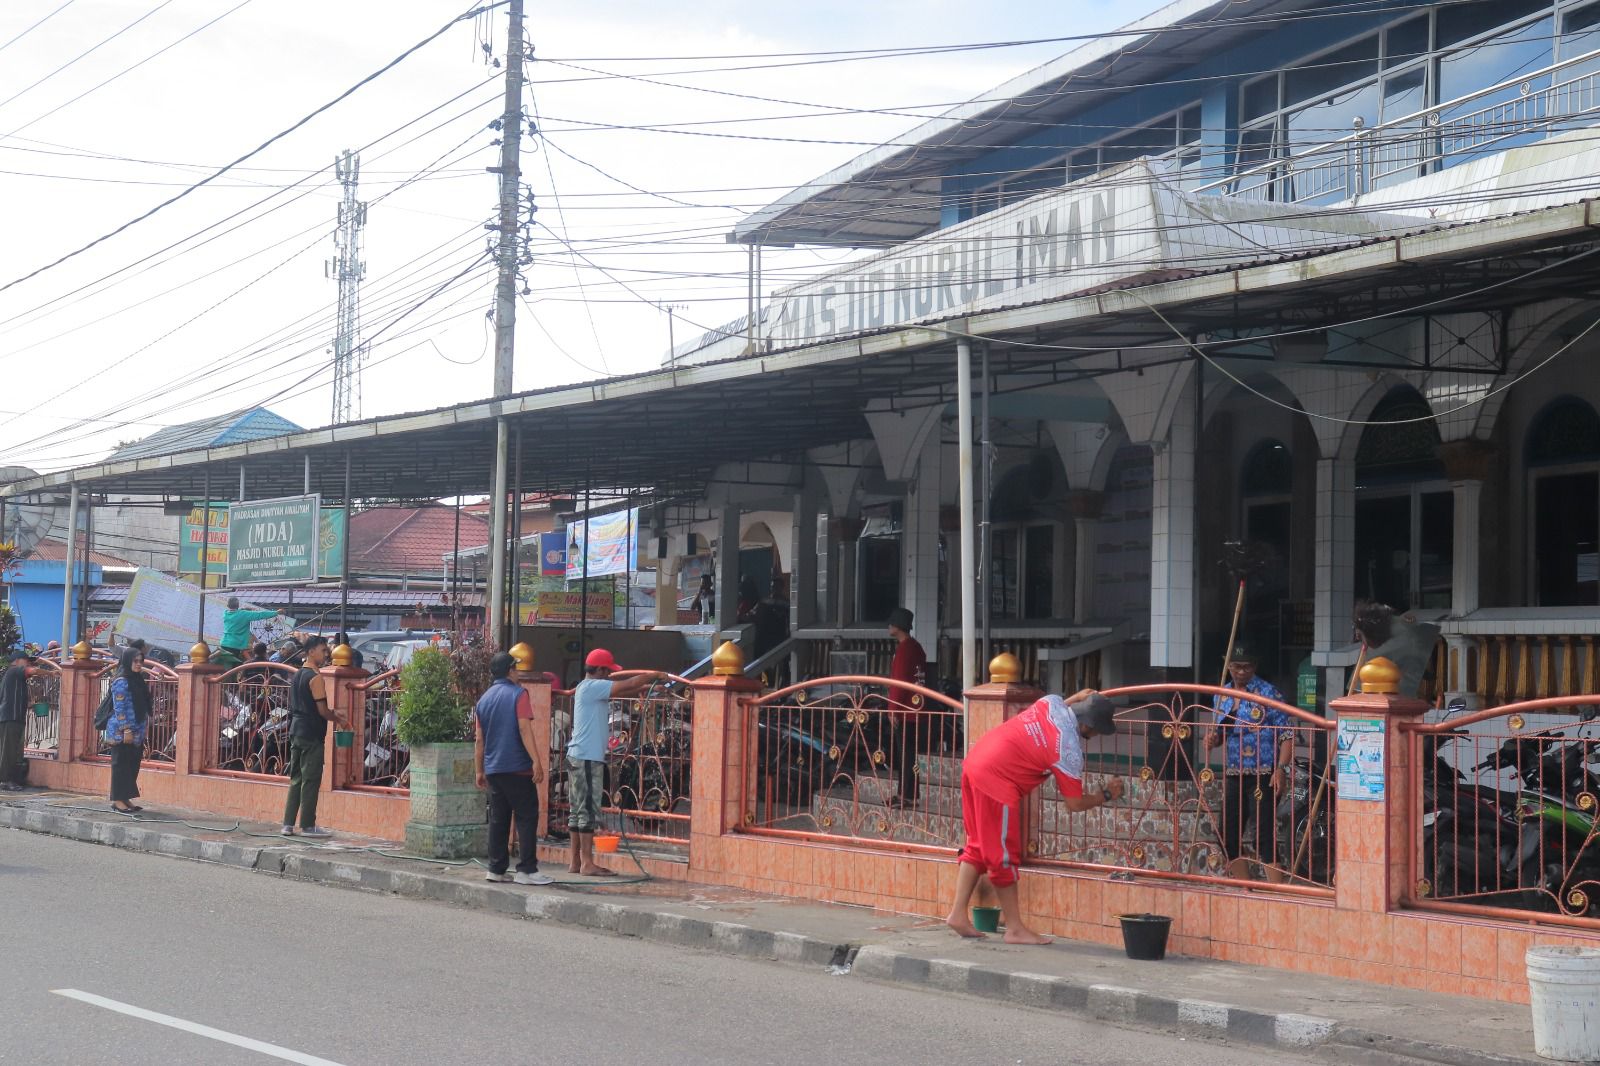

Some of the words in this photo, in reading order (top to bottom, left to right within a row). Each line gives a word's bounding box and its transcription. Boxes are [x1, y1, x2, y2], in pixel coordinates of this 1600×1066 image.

[781, 269, 884, 346] MASJID
[894, 231, 1004, 323] NURUL
[1016, 189, 1116, 289] IMAN
[248, 520, 294, 548] (MDA)
[236, 547, 261, 561] MASJID
[262, 545, 284, 559] NURUL
[287, 544, 306, 557] IMAN
